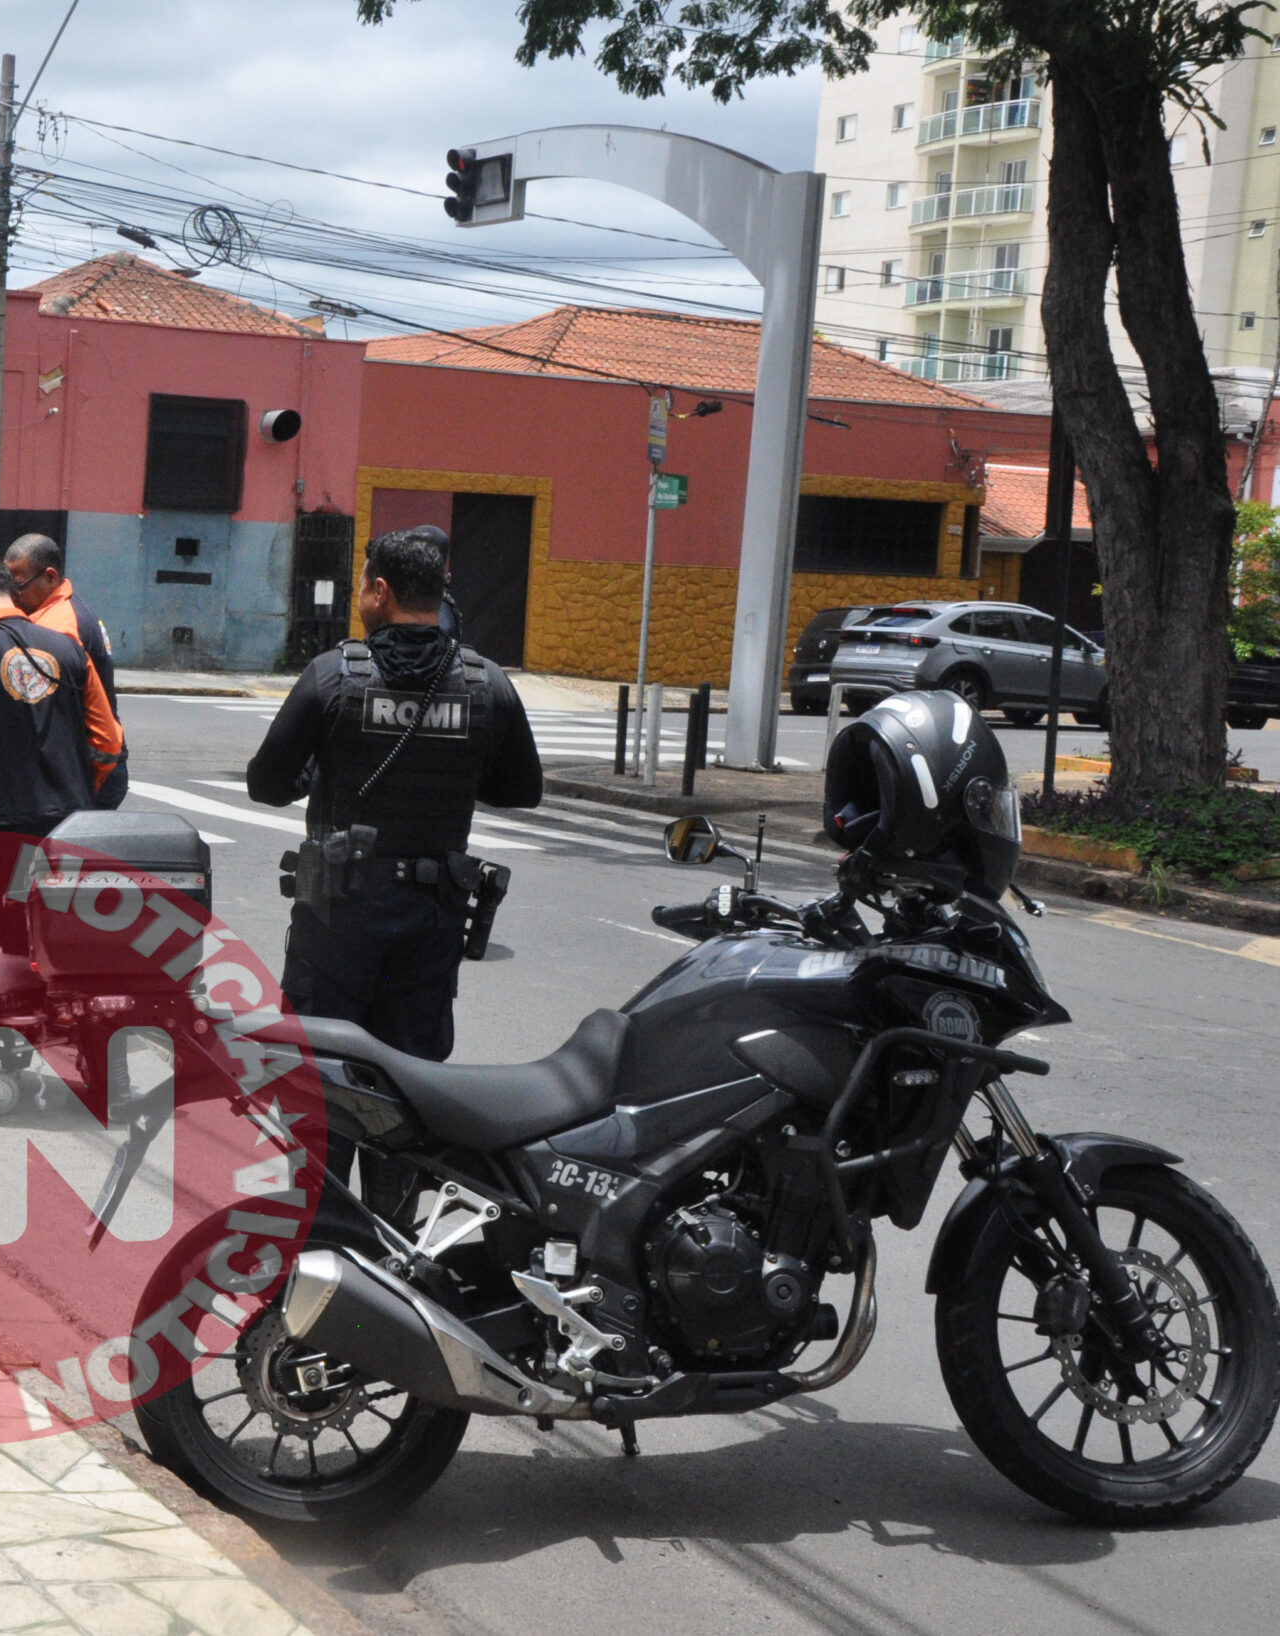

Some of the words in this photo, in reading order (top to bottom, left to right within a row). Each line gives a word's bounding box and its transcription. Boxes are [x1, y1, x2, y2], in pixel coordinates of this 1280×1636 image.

[372, 697, 462, 729] ROMI
[942, 739, 978, 793] NORISK
[940, 949, 1008, 988] CIVIL
[938, 1016, 969, 1035] ROMI
